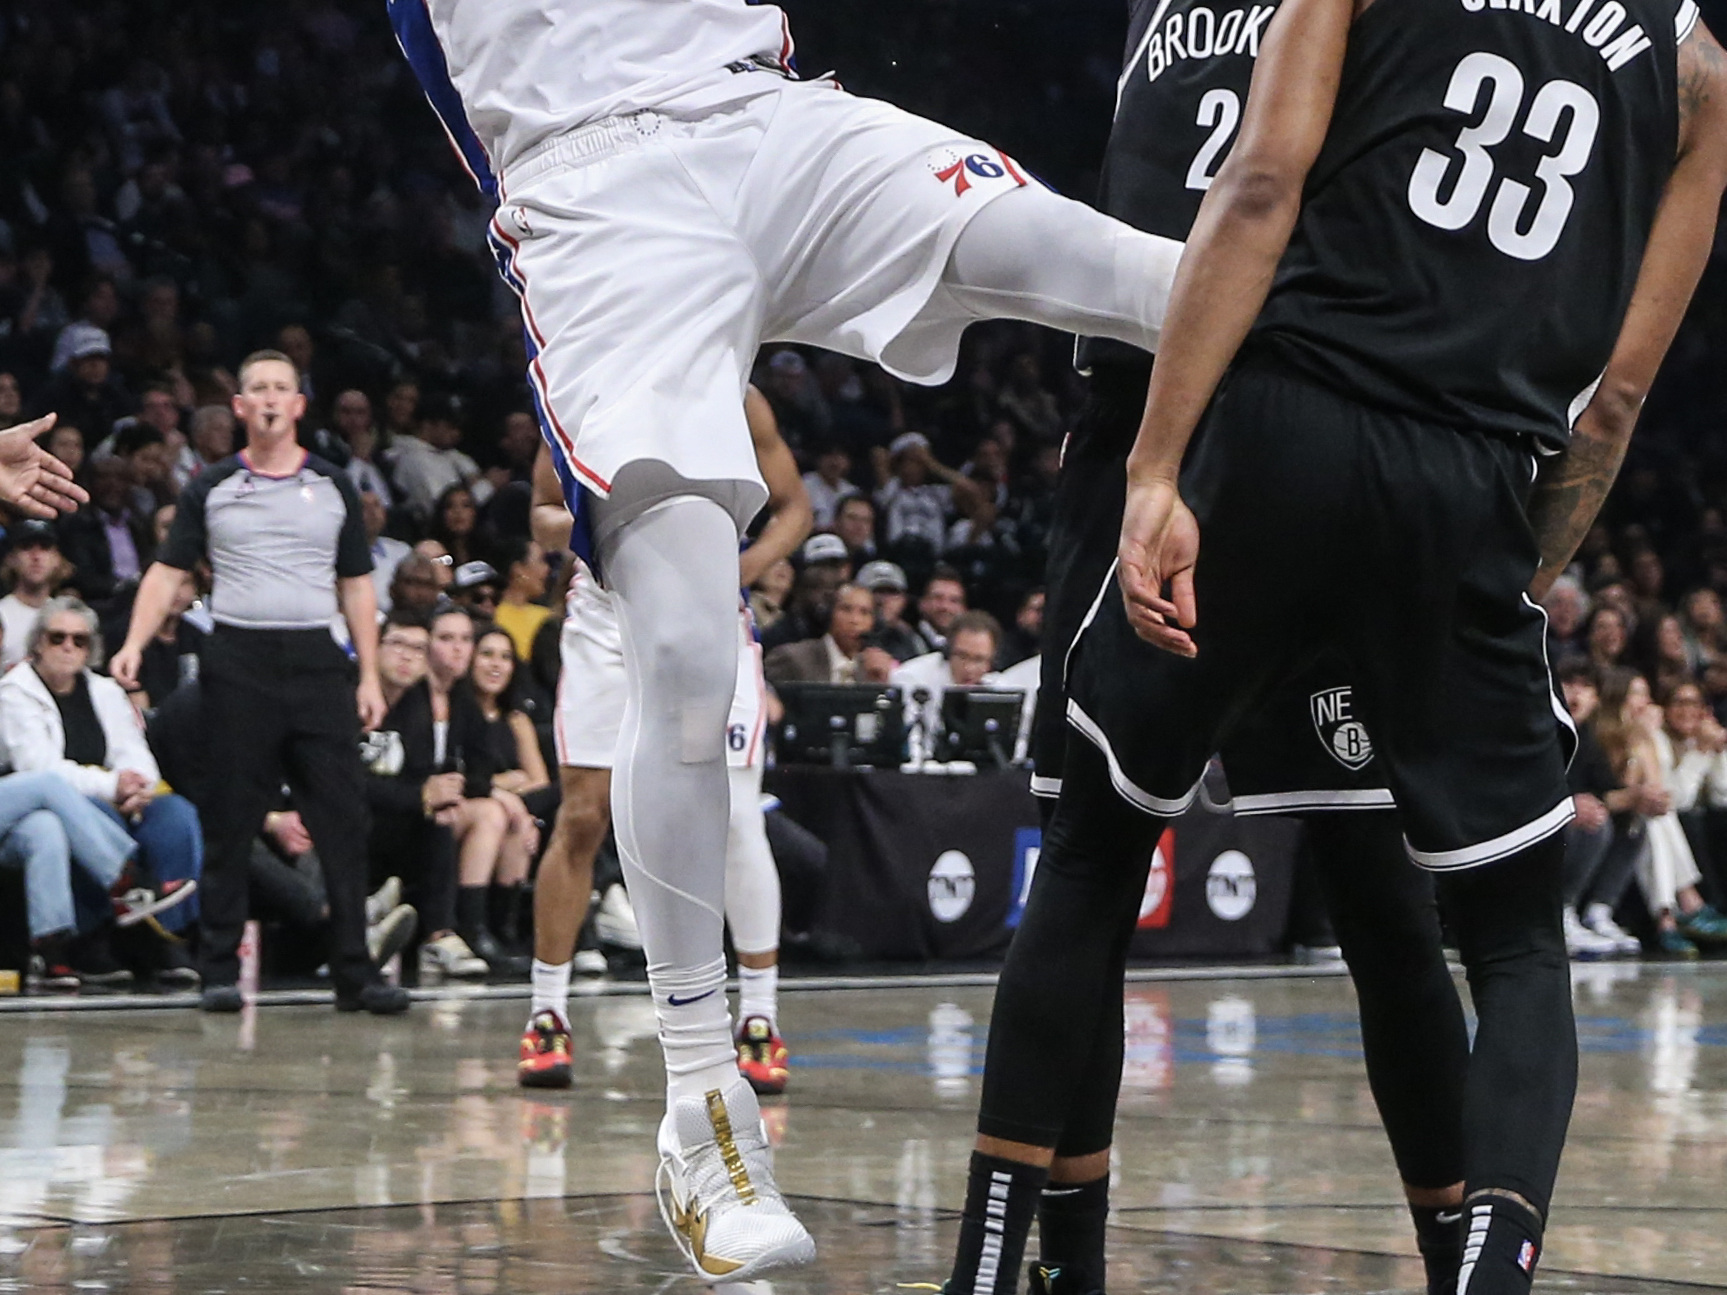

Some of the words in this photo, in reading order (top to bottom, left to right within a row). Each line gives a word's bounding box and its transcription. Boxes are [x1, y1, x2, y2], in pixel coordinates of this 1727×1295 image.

[1147, 5, 1276, 83] BROOK
[1184, 88, 1241, 191] 2
[1407, 51, 1600, 262] 33
[934, 154, 1005, 198] 76
[728, 723, 746, 752] 6
[1317, 690, 1353, 727] NE
